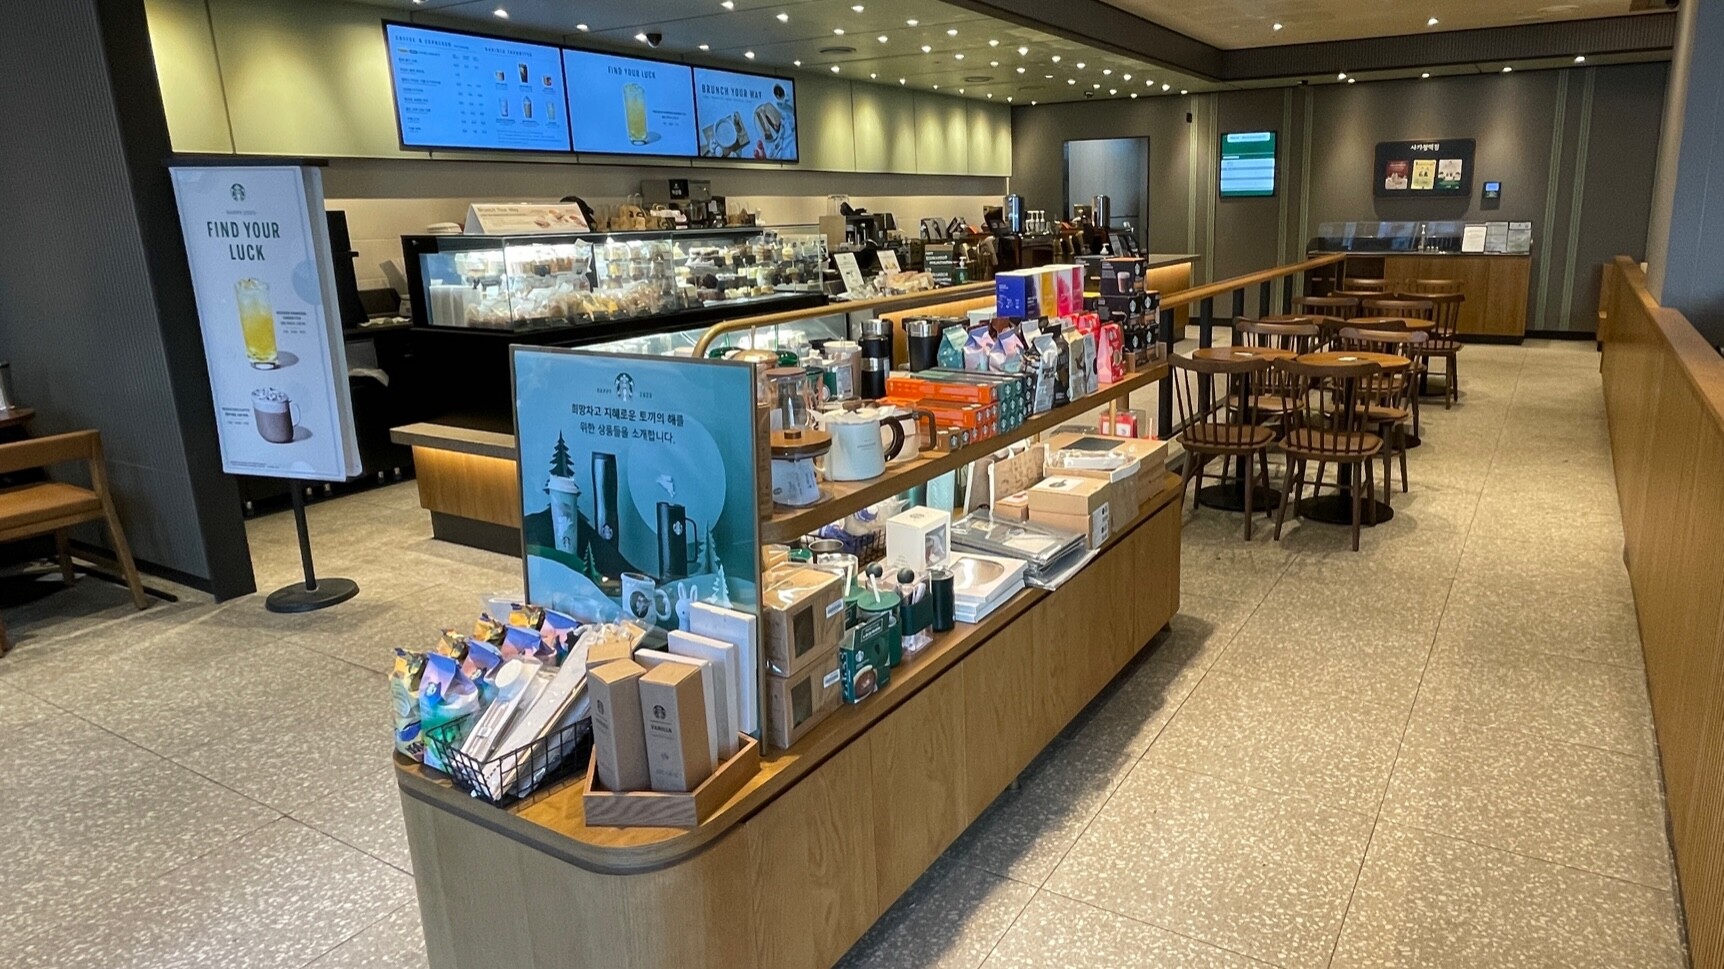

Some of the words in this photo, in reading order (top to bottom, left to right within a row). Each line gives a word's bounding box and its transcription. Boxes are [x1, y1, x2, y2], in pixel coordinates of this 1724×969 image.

[608, 65, 622, 76] FIND
[624, 68, 640, 78] YOUR
[641, 70, 656, 79] LUCK
[701, 84, 729, 96] BRUNCH
[731, 87, 748, 98] YOUR
[750, 90, 762, 100] WAY
[207, 221, 240, 238] FIND
[243, 221, 281, 239] YOUR
[229, 243, 266, 261] LUCK
[571, 403, 602, 417] 희망차고
[604, 407, 636, 422] 지혜로운
[639, 410, 665, 425] 토끼의
[667, 413, 684, 427] 해를
[580, 421, 595, 435] 위한
[598, 424, 629, 439] 상품들을
[632, 428, 676, 445] 소개합니다.
[650, 724, 673, 734] VANILLA
